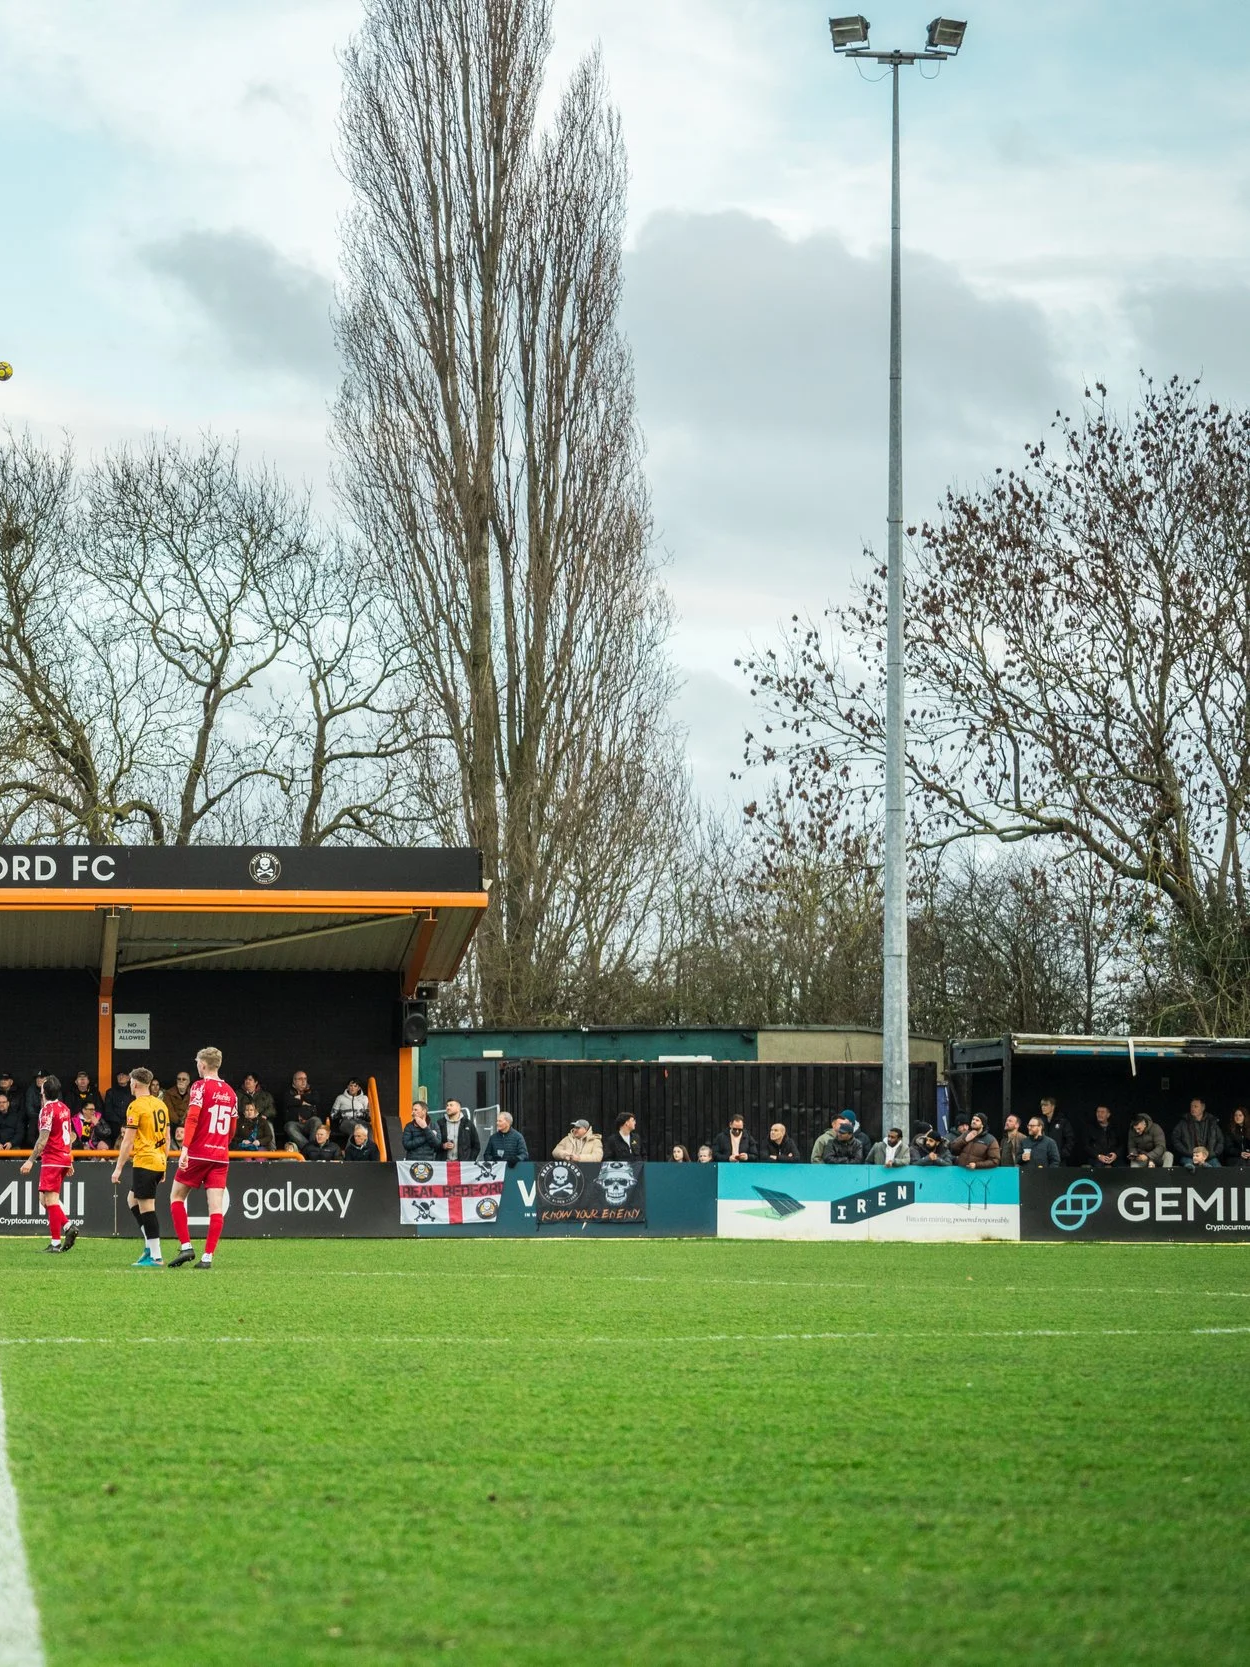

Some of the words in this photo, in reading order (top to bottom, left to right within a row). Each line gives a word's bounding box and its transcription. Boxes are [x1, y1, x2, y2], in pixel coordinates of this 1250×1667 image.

[72, 855, 116, 881] FC
[153, 1108, 166, 1132] 19
[208, 1104, 232, 1135] 15
[541, 1163, 553, 1177] REAL
[242, 1181, 354, 1220] galaxy
[402, 1185, 437, 1198] REAL
[542, 1209, 572, 1221] KNOW
[575, 1208, 598, 1219] YOUR
[601, 1208, 641, 1219] ENEMY
